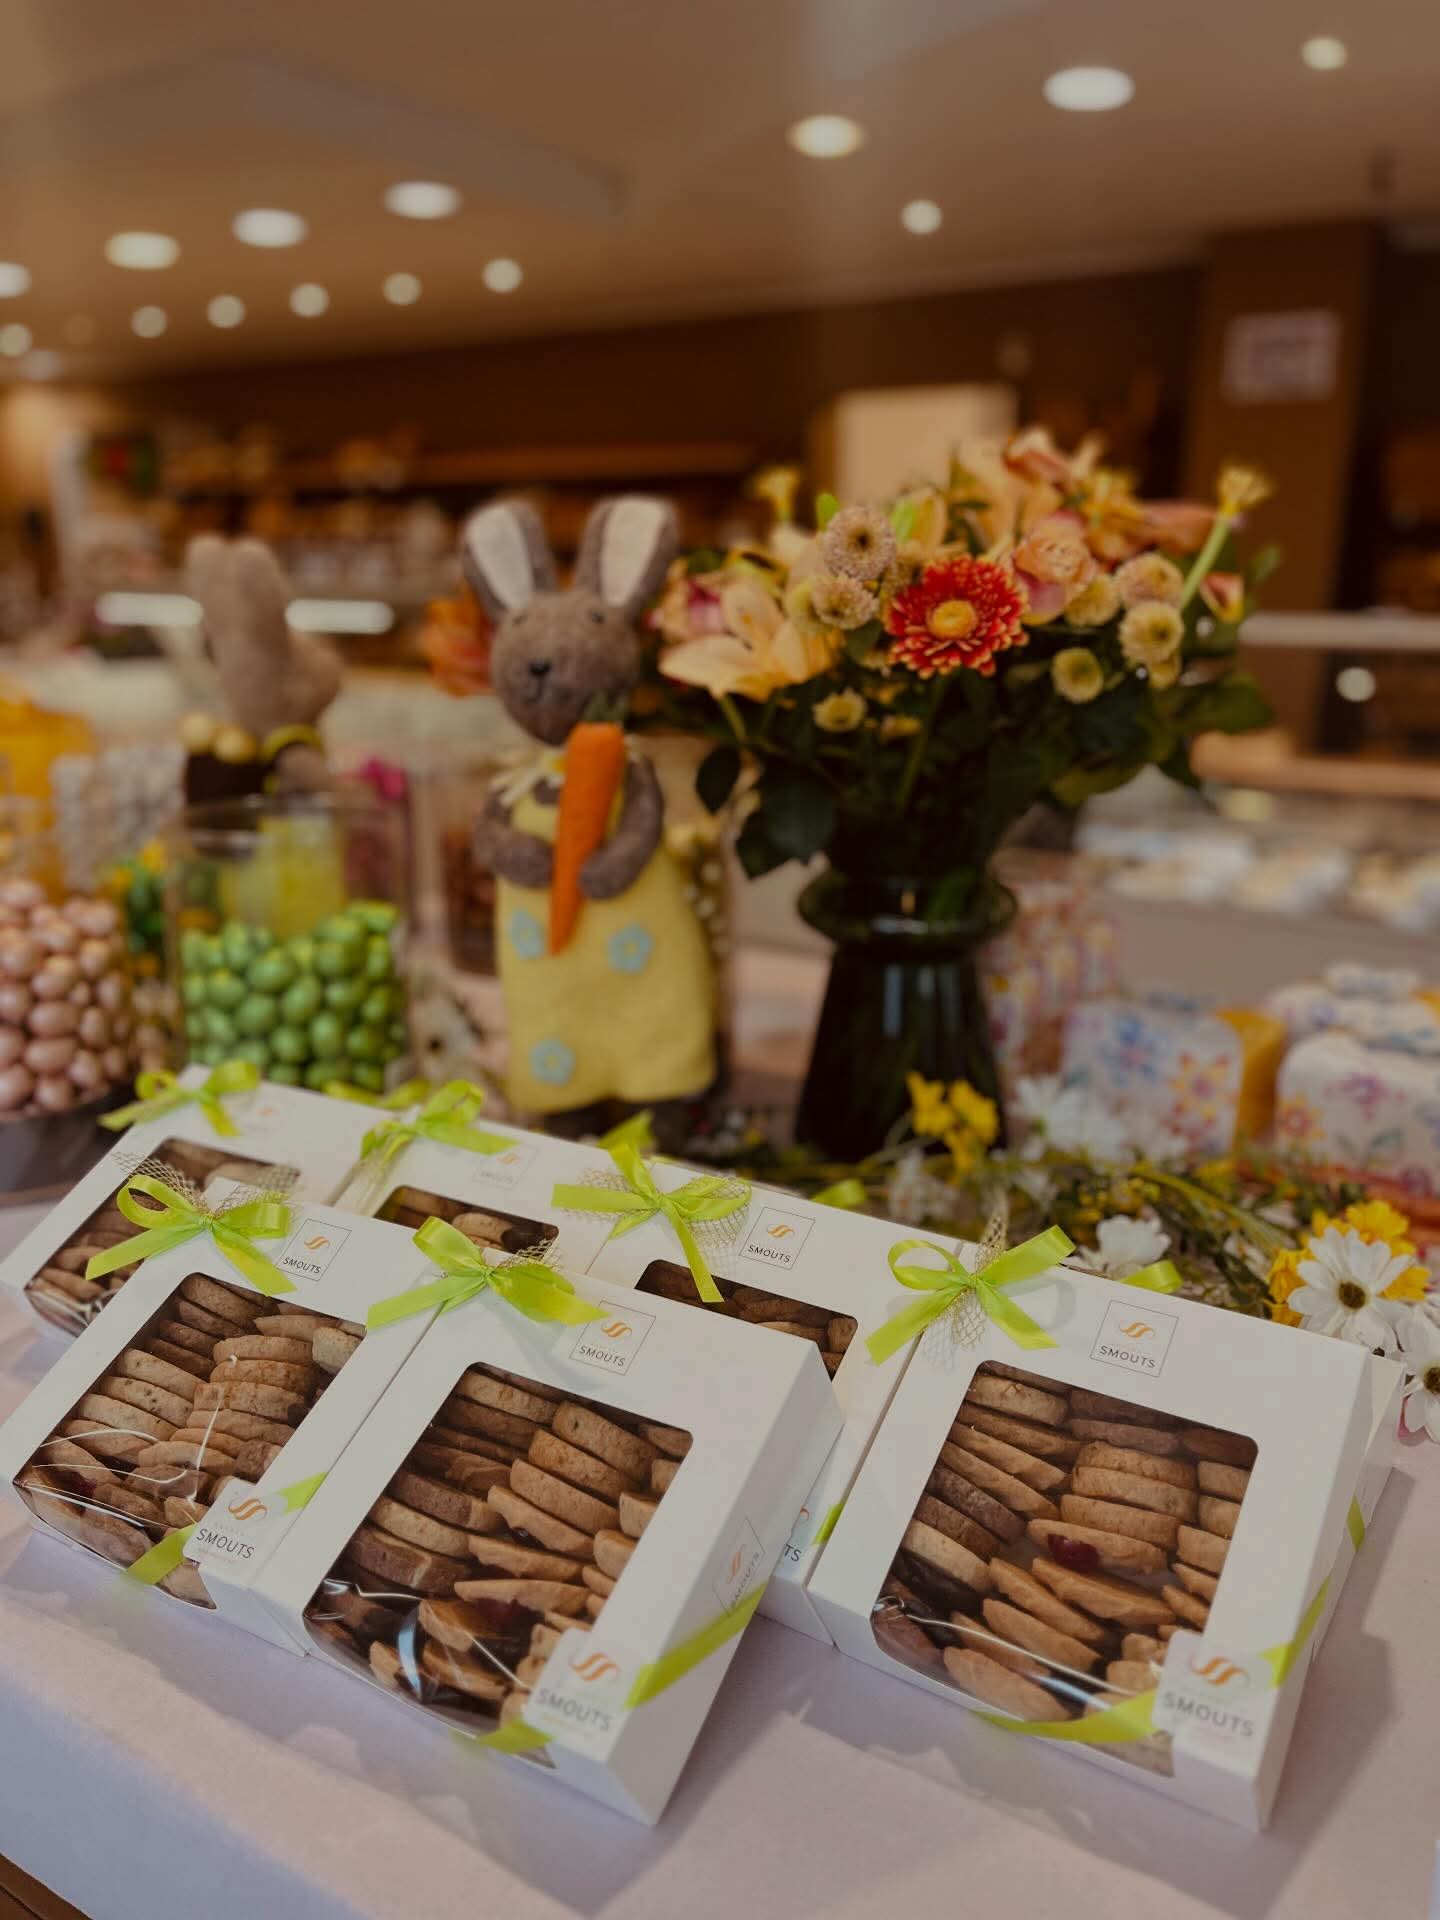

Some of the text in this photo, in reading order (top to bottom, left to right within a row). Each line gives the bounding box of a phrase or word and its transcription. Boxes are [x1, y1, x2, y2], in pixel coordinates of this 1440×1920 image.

[747, 1244, 791, 1263] SMOUTS
[282, 1257, 321, 1274] SMOUTS
[579, 1345, 626, 1367] SMOUTS
[1099, 1345, 1155, 1368] SMOUTS
[196, 1528, 255, 1559] SMOUTS
[536, 1687, 614, 1732] SMOUTS
[1163, 1691, 1254, 1737] SMOUTS
